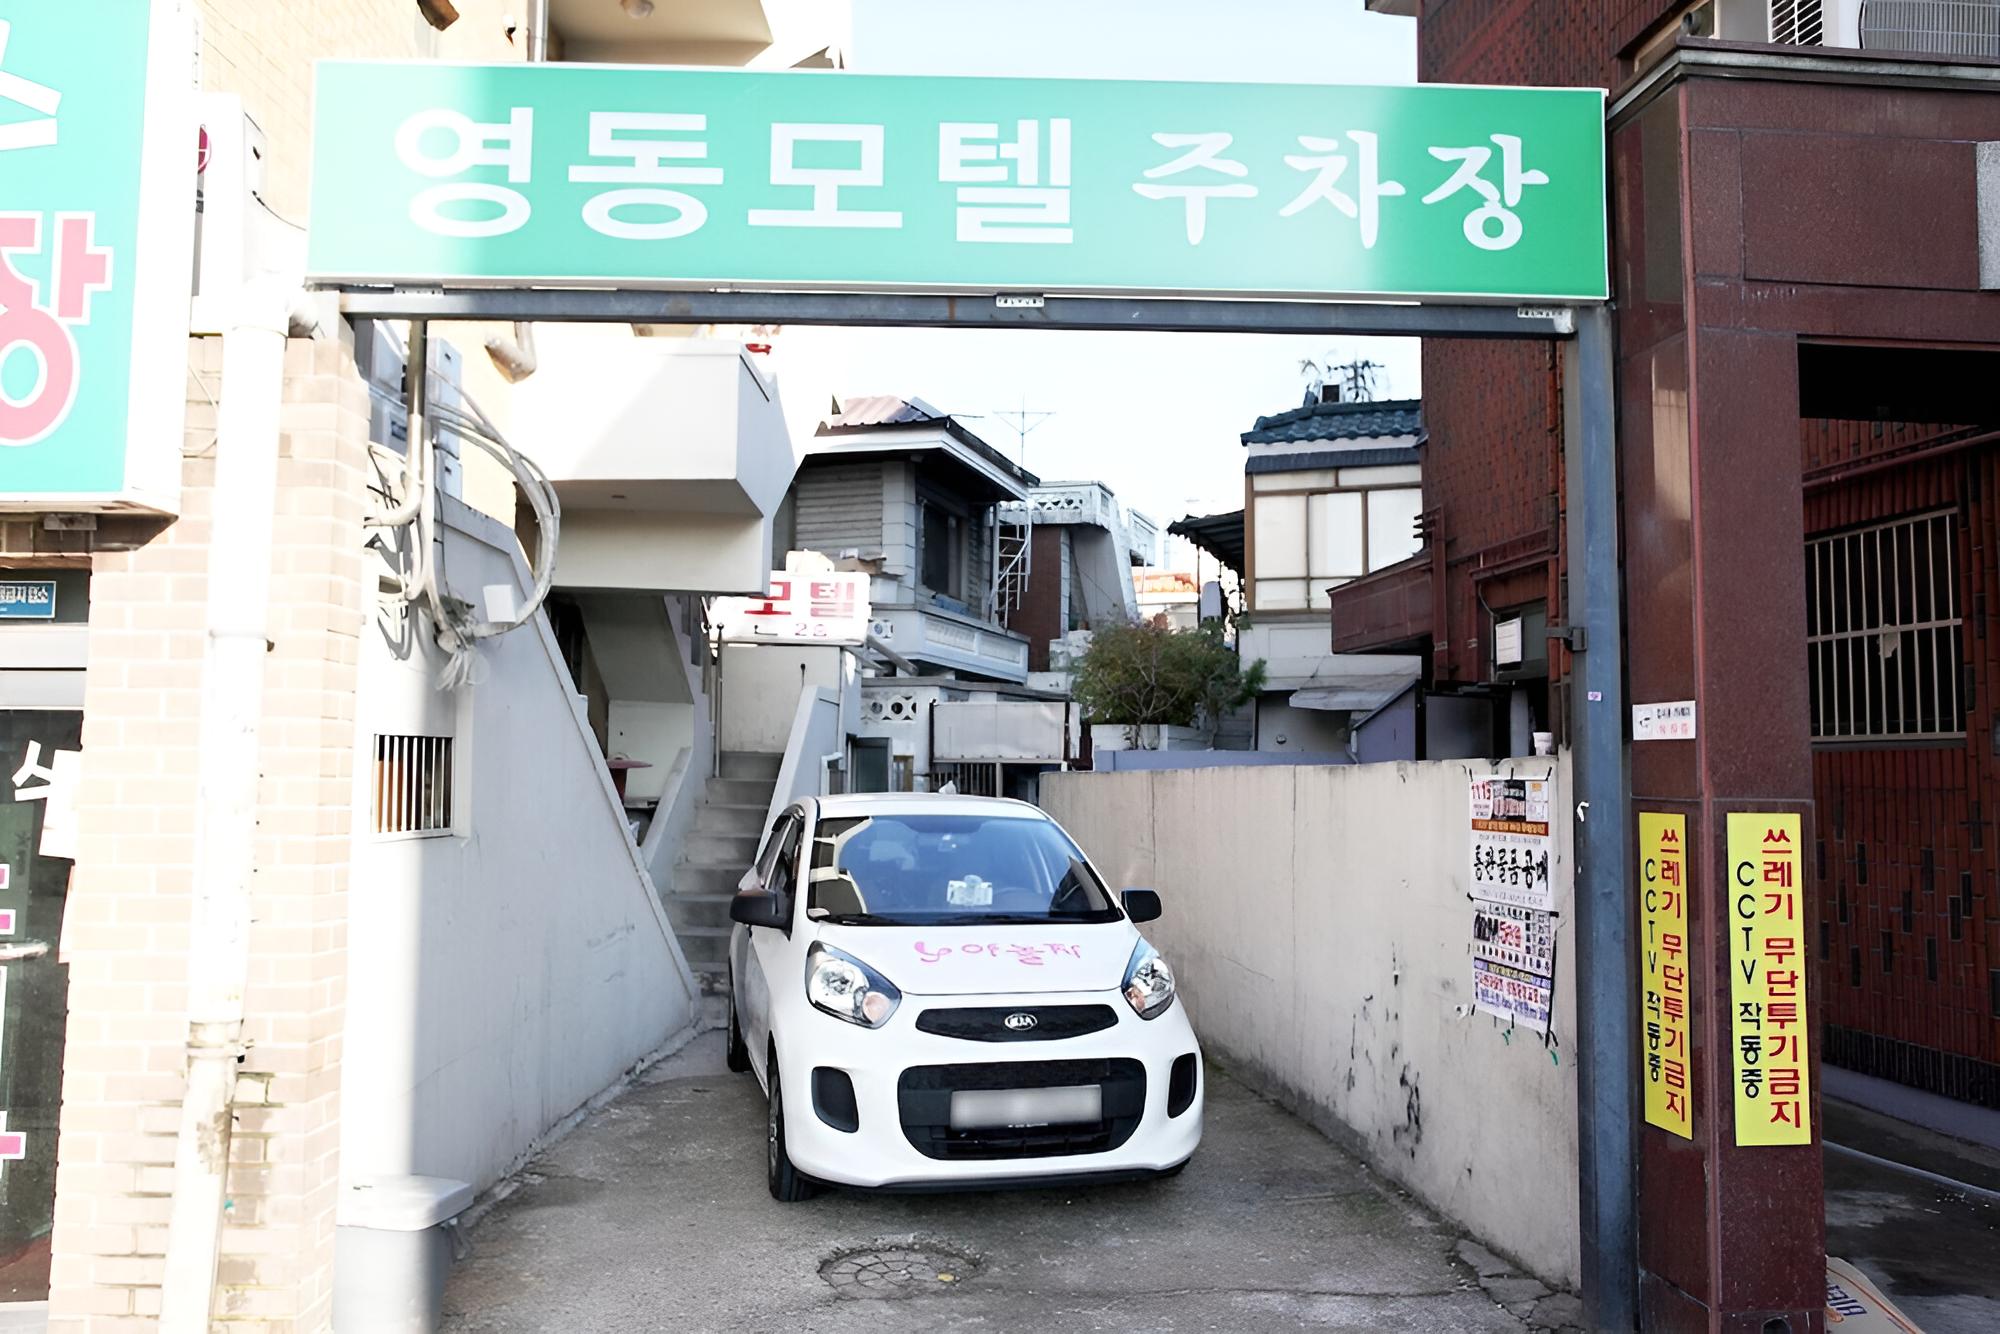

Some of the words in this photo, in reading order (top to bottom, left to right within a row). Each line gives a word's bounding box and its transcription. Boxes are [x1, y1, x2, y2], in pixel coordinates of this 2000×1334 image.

[394, 106, 1074, 246] 영동모텔
[1131, 129, 1550, 251] 주차장
[1645, 858, 1657, 974] CCTV
[1660, 828, 1681, 919] 쓰레기
[1736, 861, 1757, 985] CCTV
[1762, 829, 1793, 920] 쓰레기
[1647, 990, 1661, 1083] 작동중
[1662, 933, 1686, 1123] 무단투기금지
[1739, 1003, 1763, 1099] 작동중
[1764, 938, 1801, 1129] 무단투기금지
